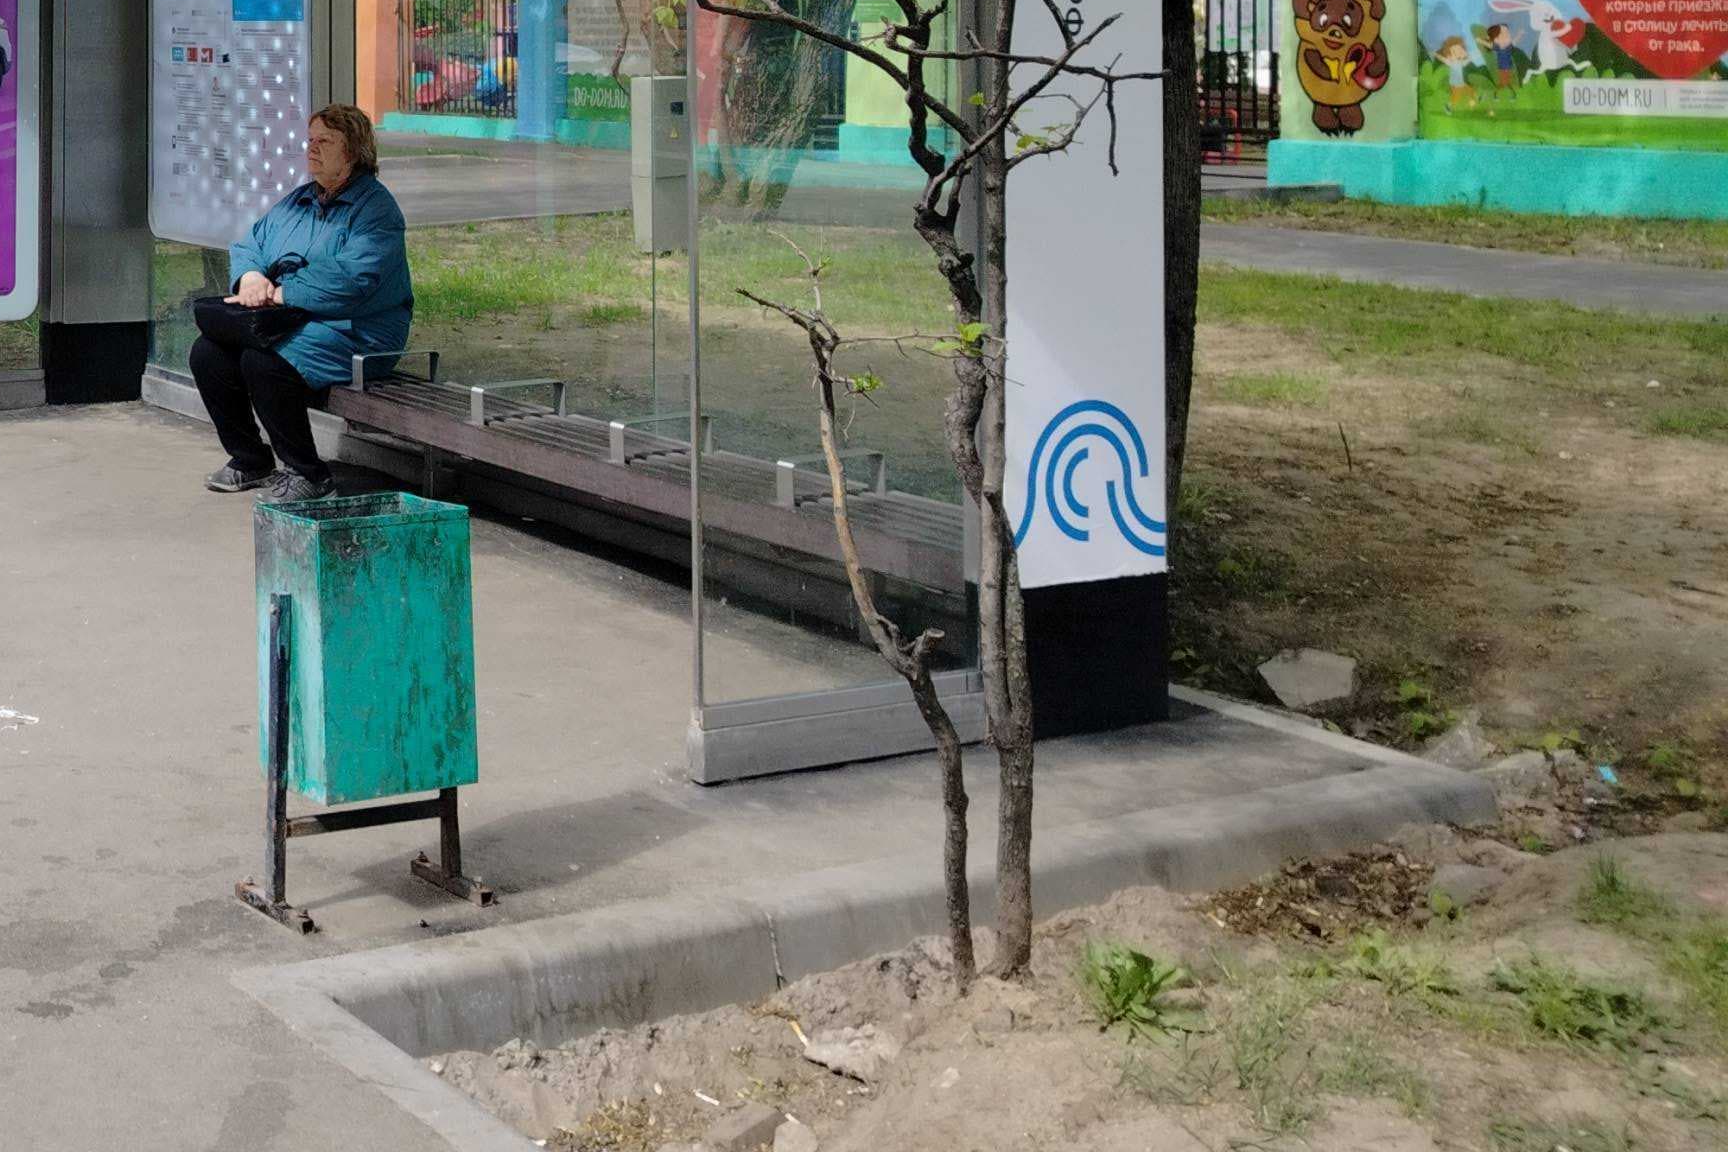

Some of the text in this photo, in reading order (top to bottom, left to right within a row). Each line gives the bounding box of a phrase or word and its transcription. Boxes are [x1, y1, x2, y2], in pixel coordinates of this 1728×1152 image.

[1605, 0, 1666, 14] которые
[1612, 21, 1622, 33] в
[1624, 20, 1677, 34] столицу
[1648, 38, 1705, 54] от рака.
[1573, 87, 1652, 108] DO-DOM.RU
